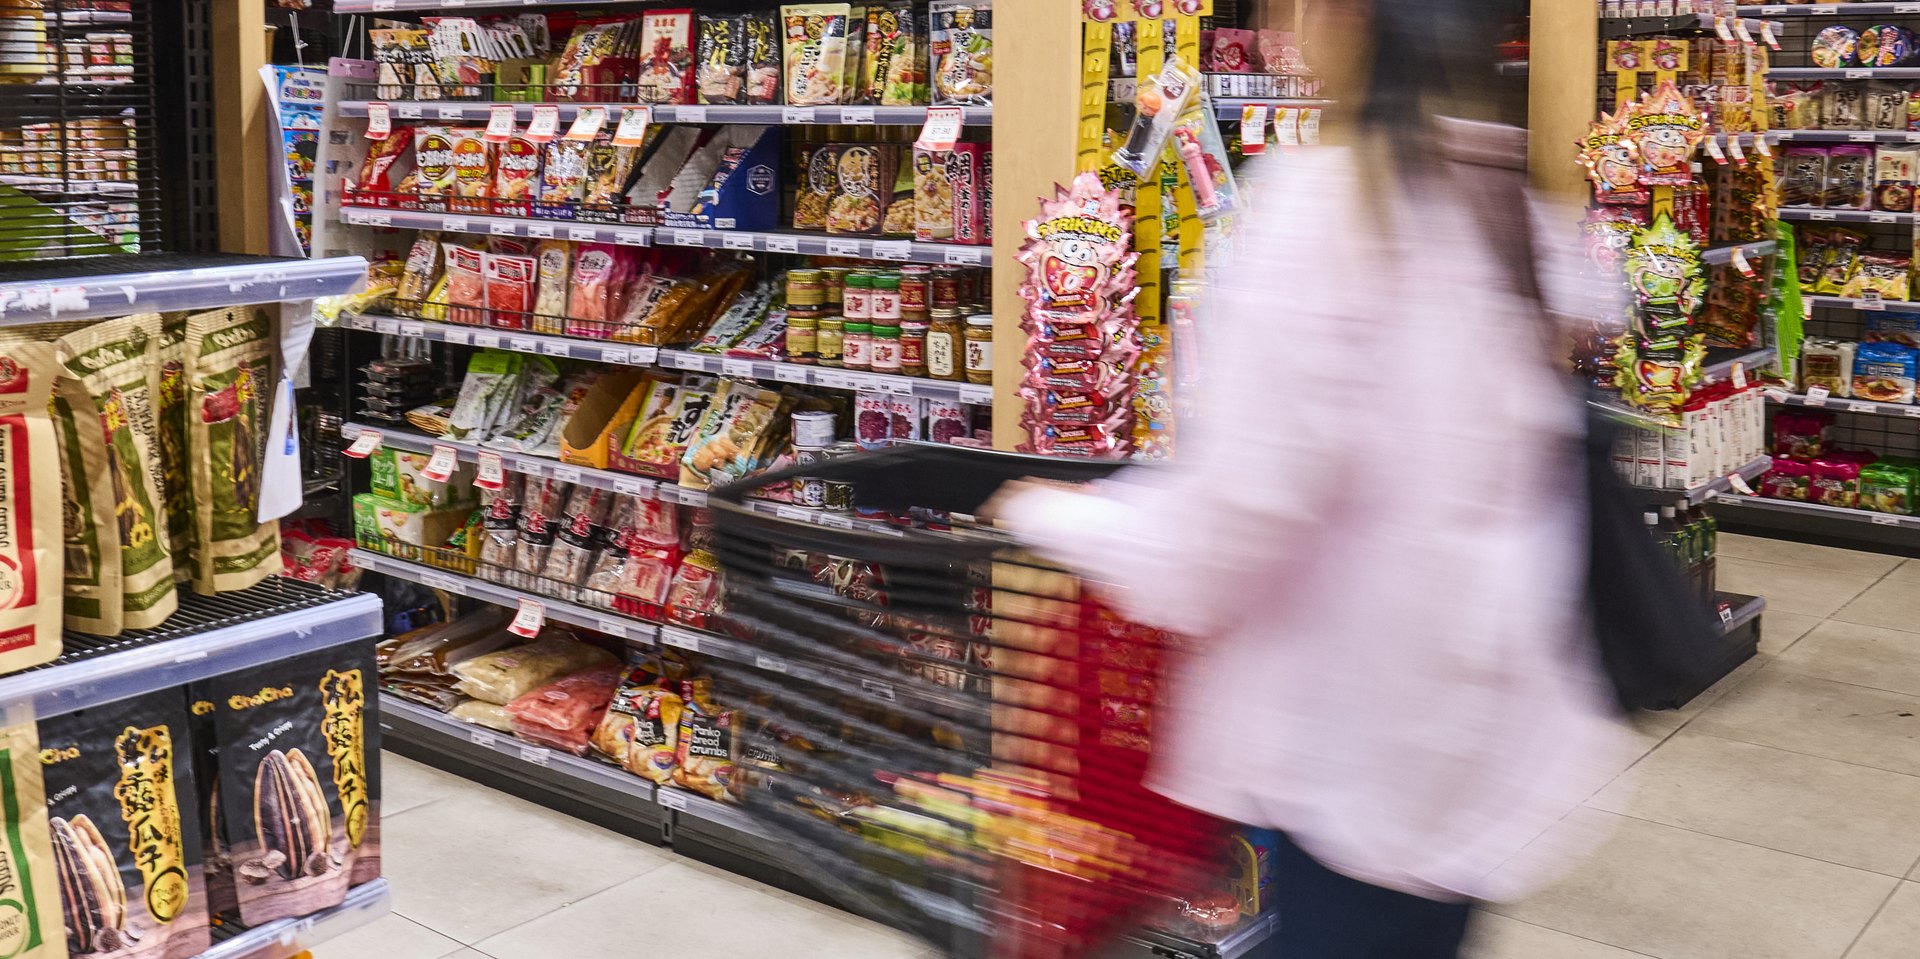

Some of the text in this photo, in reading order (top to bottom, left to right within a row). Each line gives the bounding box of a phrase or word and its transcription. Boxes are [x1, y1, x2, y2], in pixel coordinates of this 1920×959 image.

[1627, 114, 1702, 132] STRIKING
[1036, 216, 1122, 243] STRIKING
[227, 686, 294, 711] ChaCha
[248, 737, 270, 751] Tasty
[273, 721, 293, 736] Crispy
[692, 724, 721, 737] Panko
[692, 735, 720, 747] bread
[690, 745, 728, 757] crumbs
[53, 784, 78, 802] Crispy
